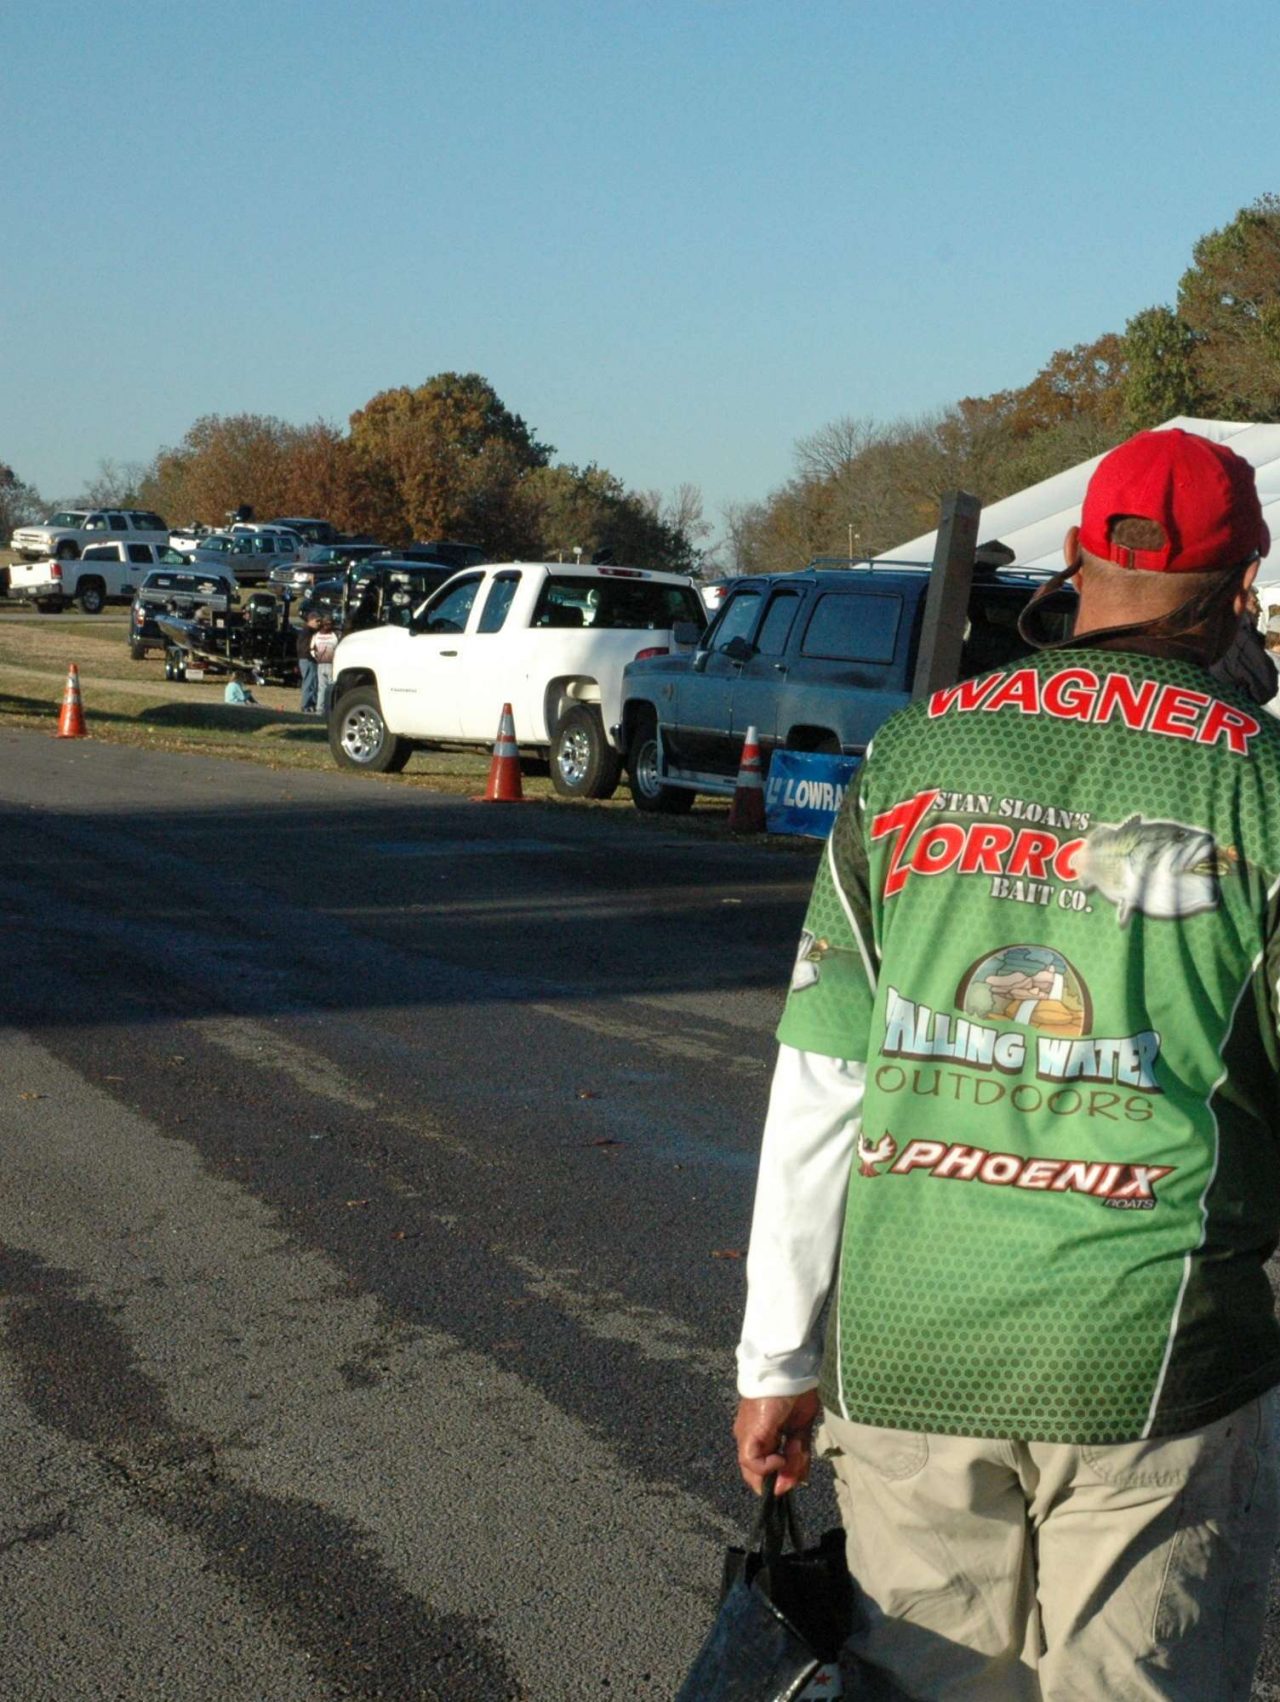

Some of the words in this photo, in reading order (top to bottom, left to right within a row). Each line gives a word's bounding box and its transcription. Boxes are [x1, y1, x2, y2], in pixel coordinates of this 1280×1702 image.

[927, 667, 1261, 756] WAGNER
[932, 791, 993, 815] STAN
[998, 796, 1091, 832] SLOAN'S
[988, 875, 1055, 906] BAIT
[1056, 888, 1093, 913] CO.
[1036, 1029, 1164, 1095] WATER
[875, 1064, 1155, 1122] OUTDOORS
[890, 1138, 1178, 1199] PHOENIX
